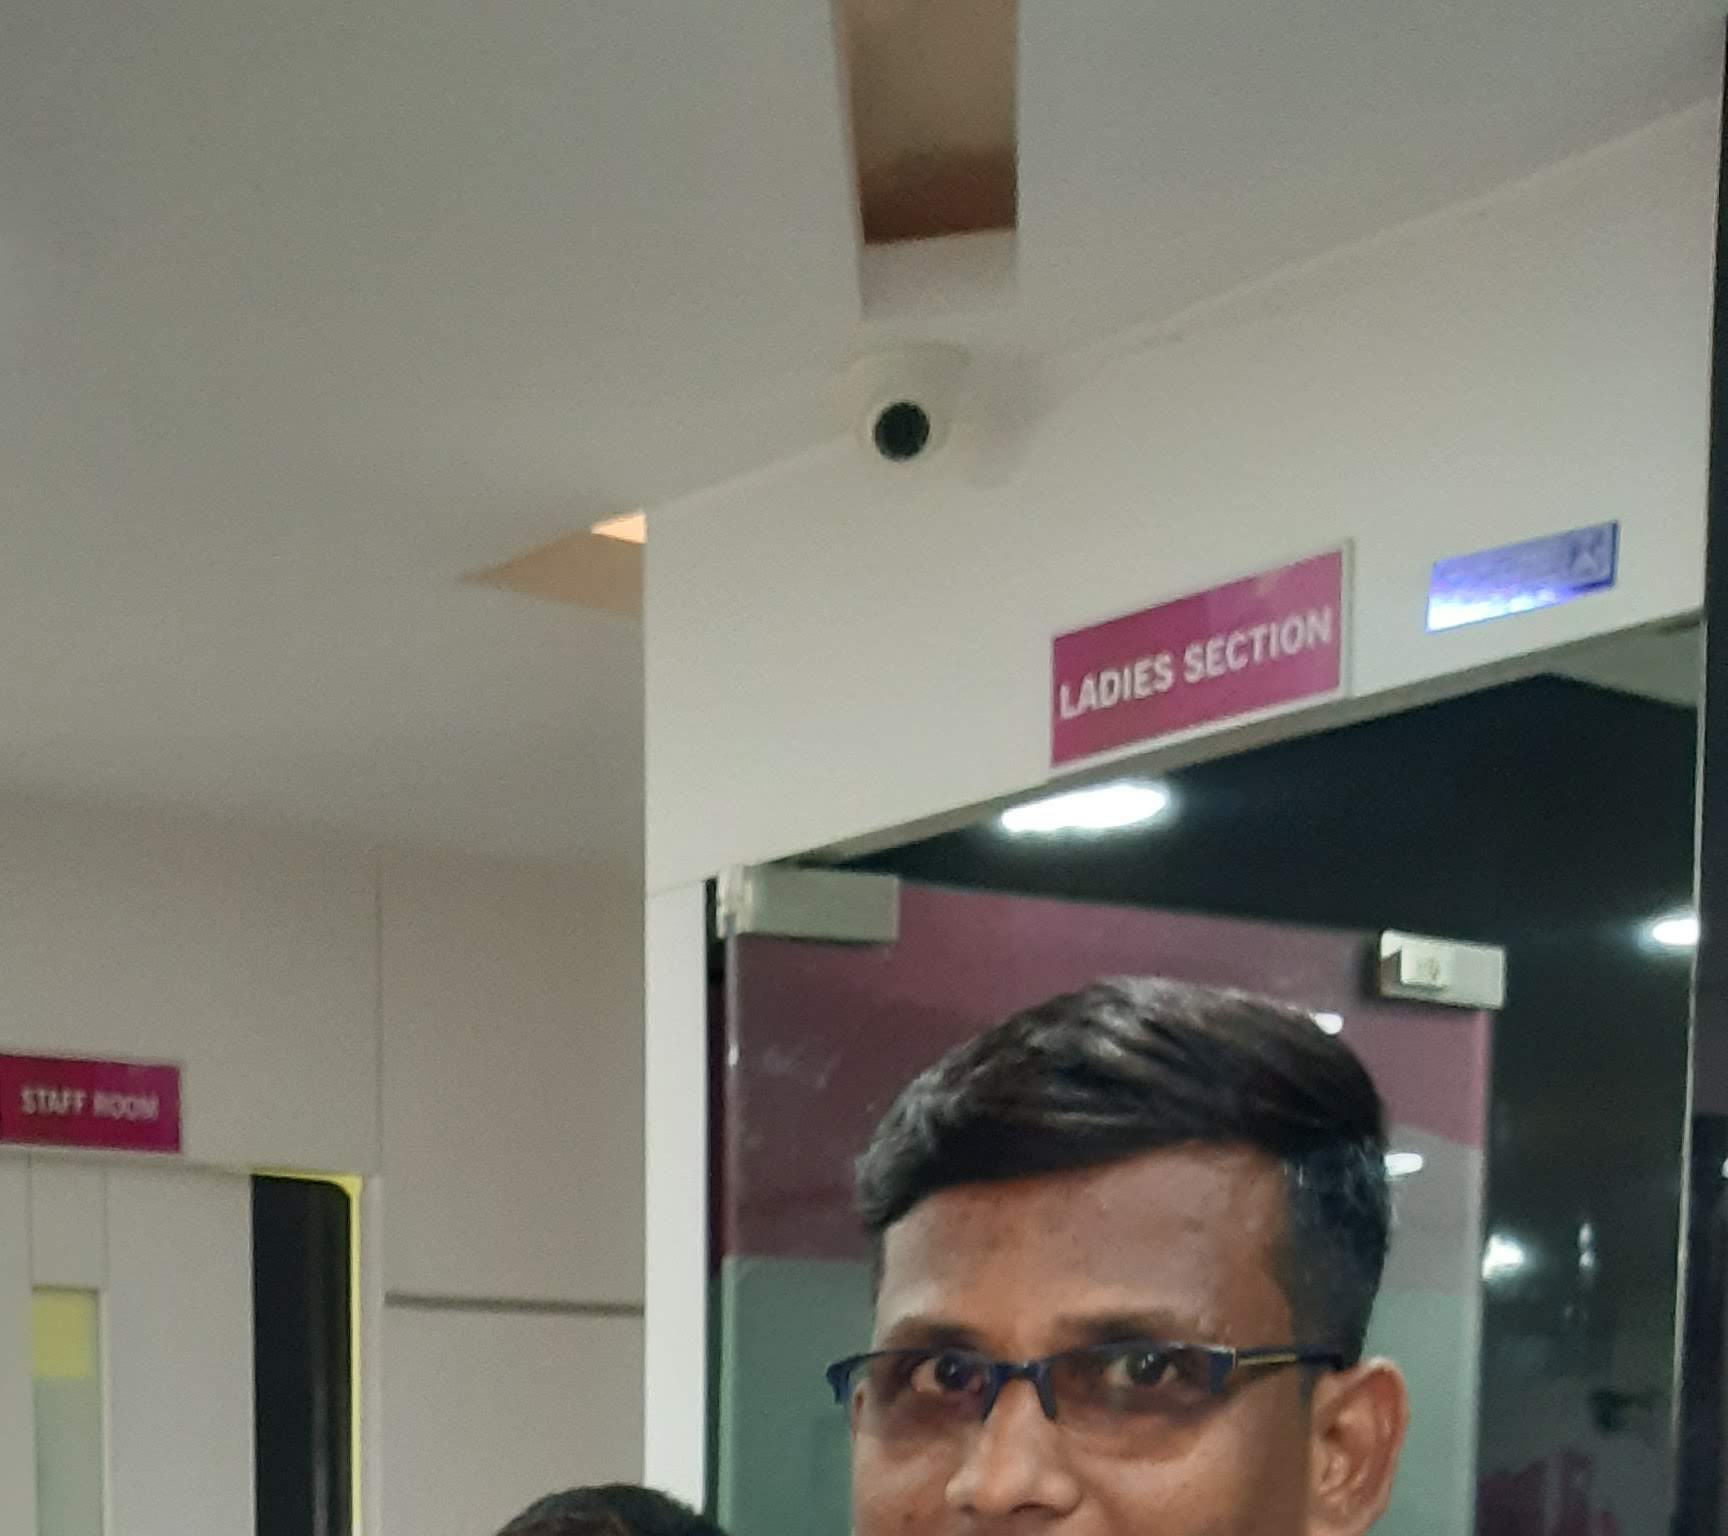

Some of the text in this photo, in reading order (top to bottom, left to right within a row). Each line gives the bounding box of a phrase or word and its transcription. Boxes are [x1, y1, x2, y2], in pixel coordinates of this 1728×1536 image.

[1057, 606, 1334, 719] LADIES SECTION
[22, 1087, 160, 1121] STAFF ROOM
